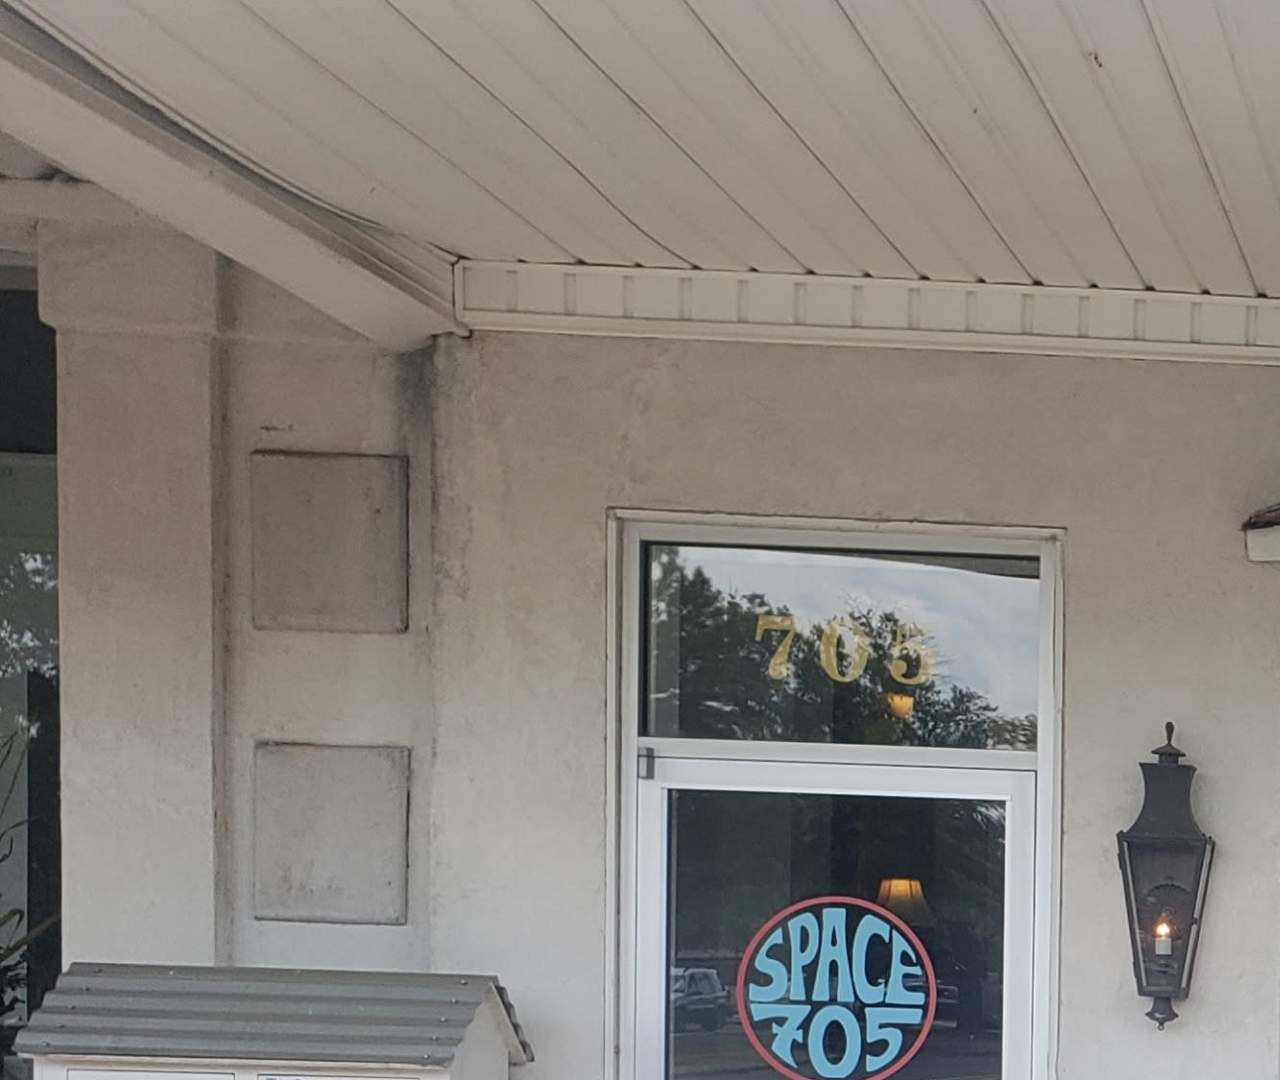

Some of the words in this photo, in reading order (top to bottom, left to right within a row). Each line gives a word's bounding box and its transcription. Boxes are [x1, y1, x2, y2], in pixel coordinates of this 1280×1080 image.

[755, 614, 934, 685] 705
[749, 907, 926, 1005] SPACE
[750, 1003, 924, 1079] 705
